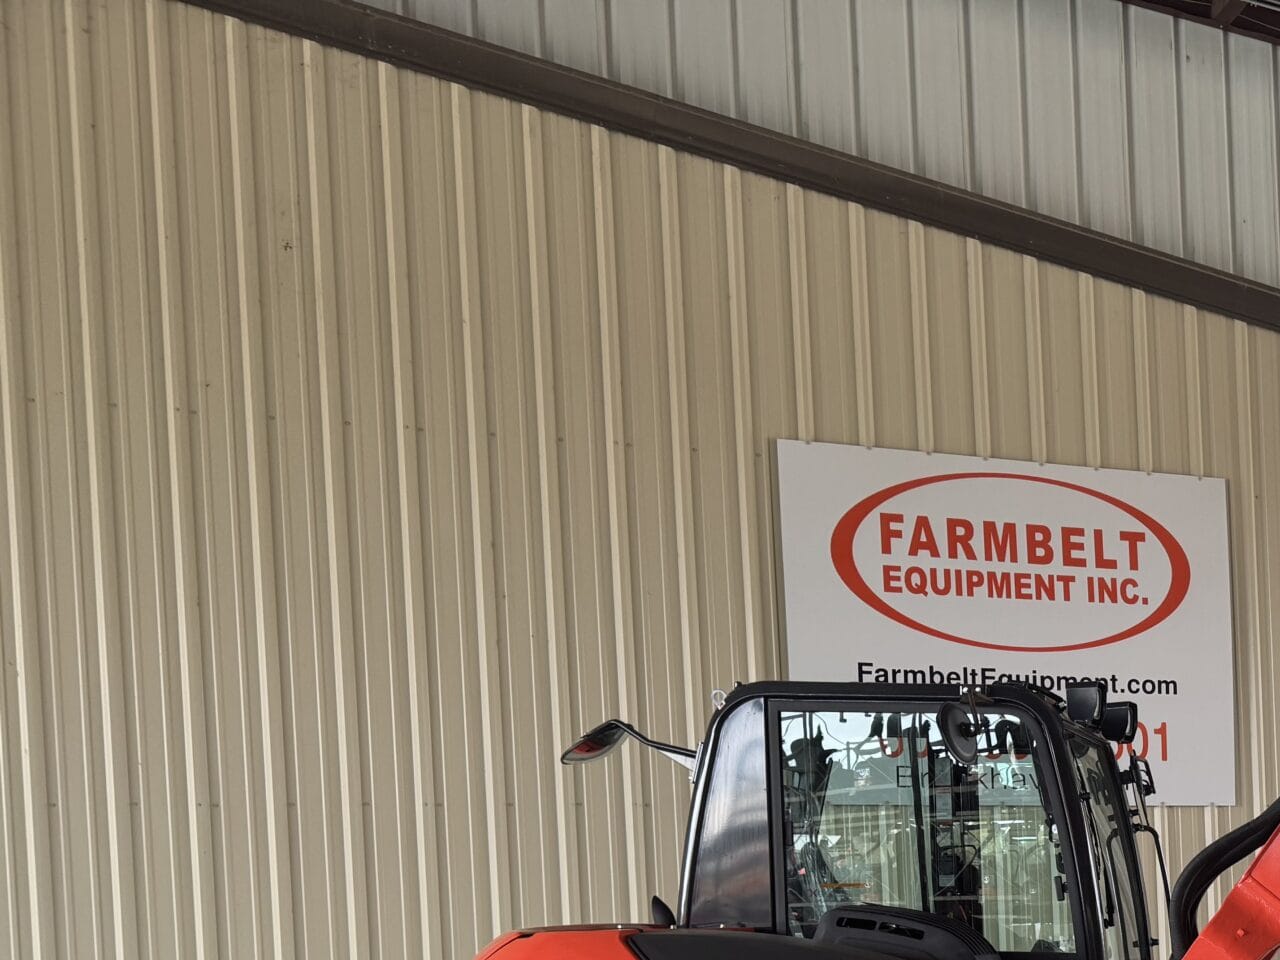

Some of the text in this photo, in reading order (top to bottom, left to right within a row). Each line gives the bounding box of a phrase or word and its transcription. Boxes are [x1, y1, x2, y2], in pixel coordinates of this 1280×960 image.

[879, 512, 1146, 571] FARMBELT
[882, 565, 1150, 606] EQUIPMENT INC.
[857, 661, 1179, 696] FarmbeltEuipmt.com
